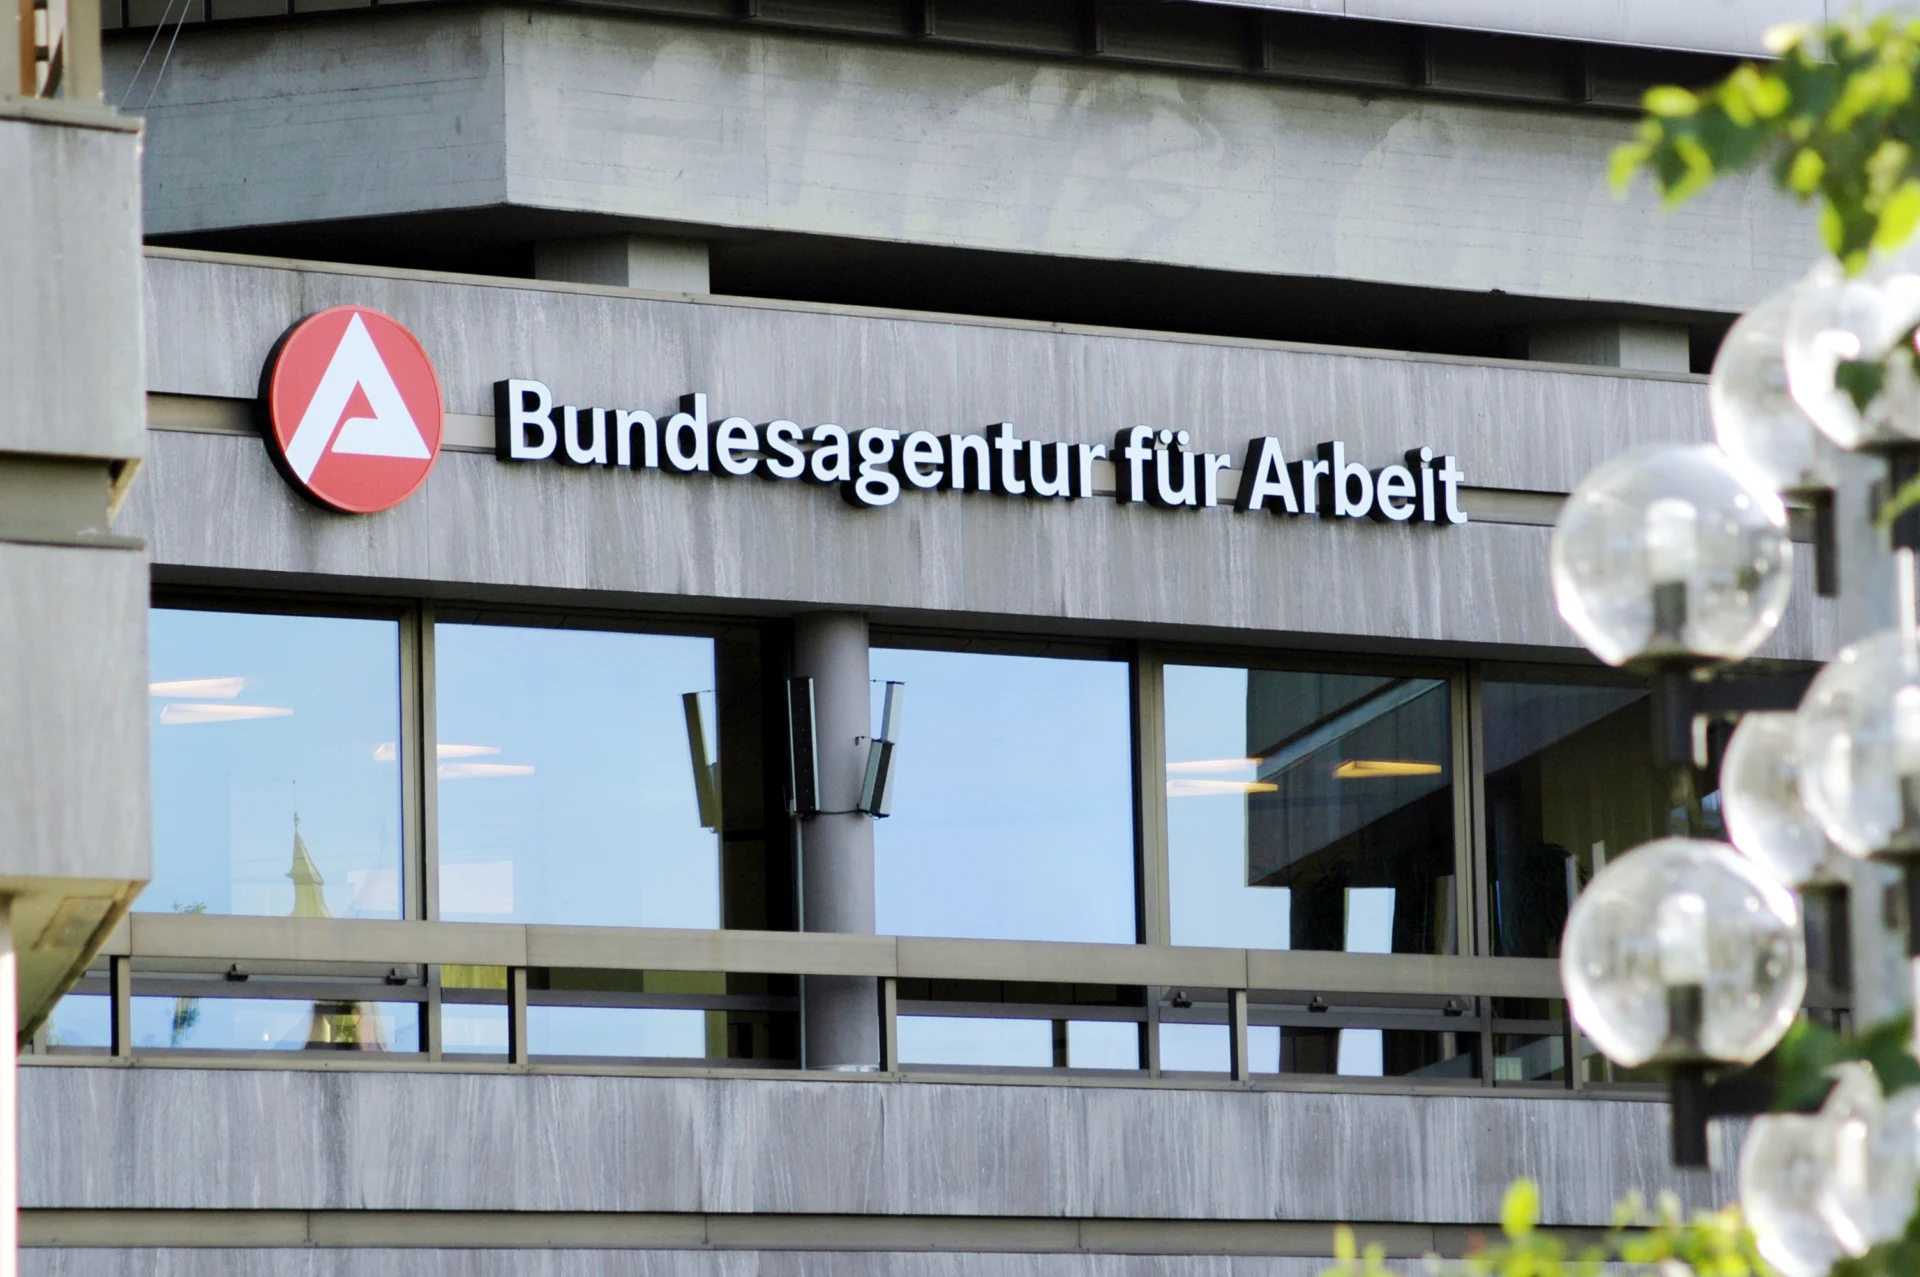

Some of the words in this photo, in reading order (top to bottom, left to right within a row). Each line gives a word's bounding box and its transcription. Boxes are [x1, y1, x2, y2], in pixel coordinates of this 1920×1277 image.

[506, 378, 1106, 506] Bundesagentur
[1124, 424, 1231, 507] für
[1248, 435, 1468, 525] Arbeit
